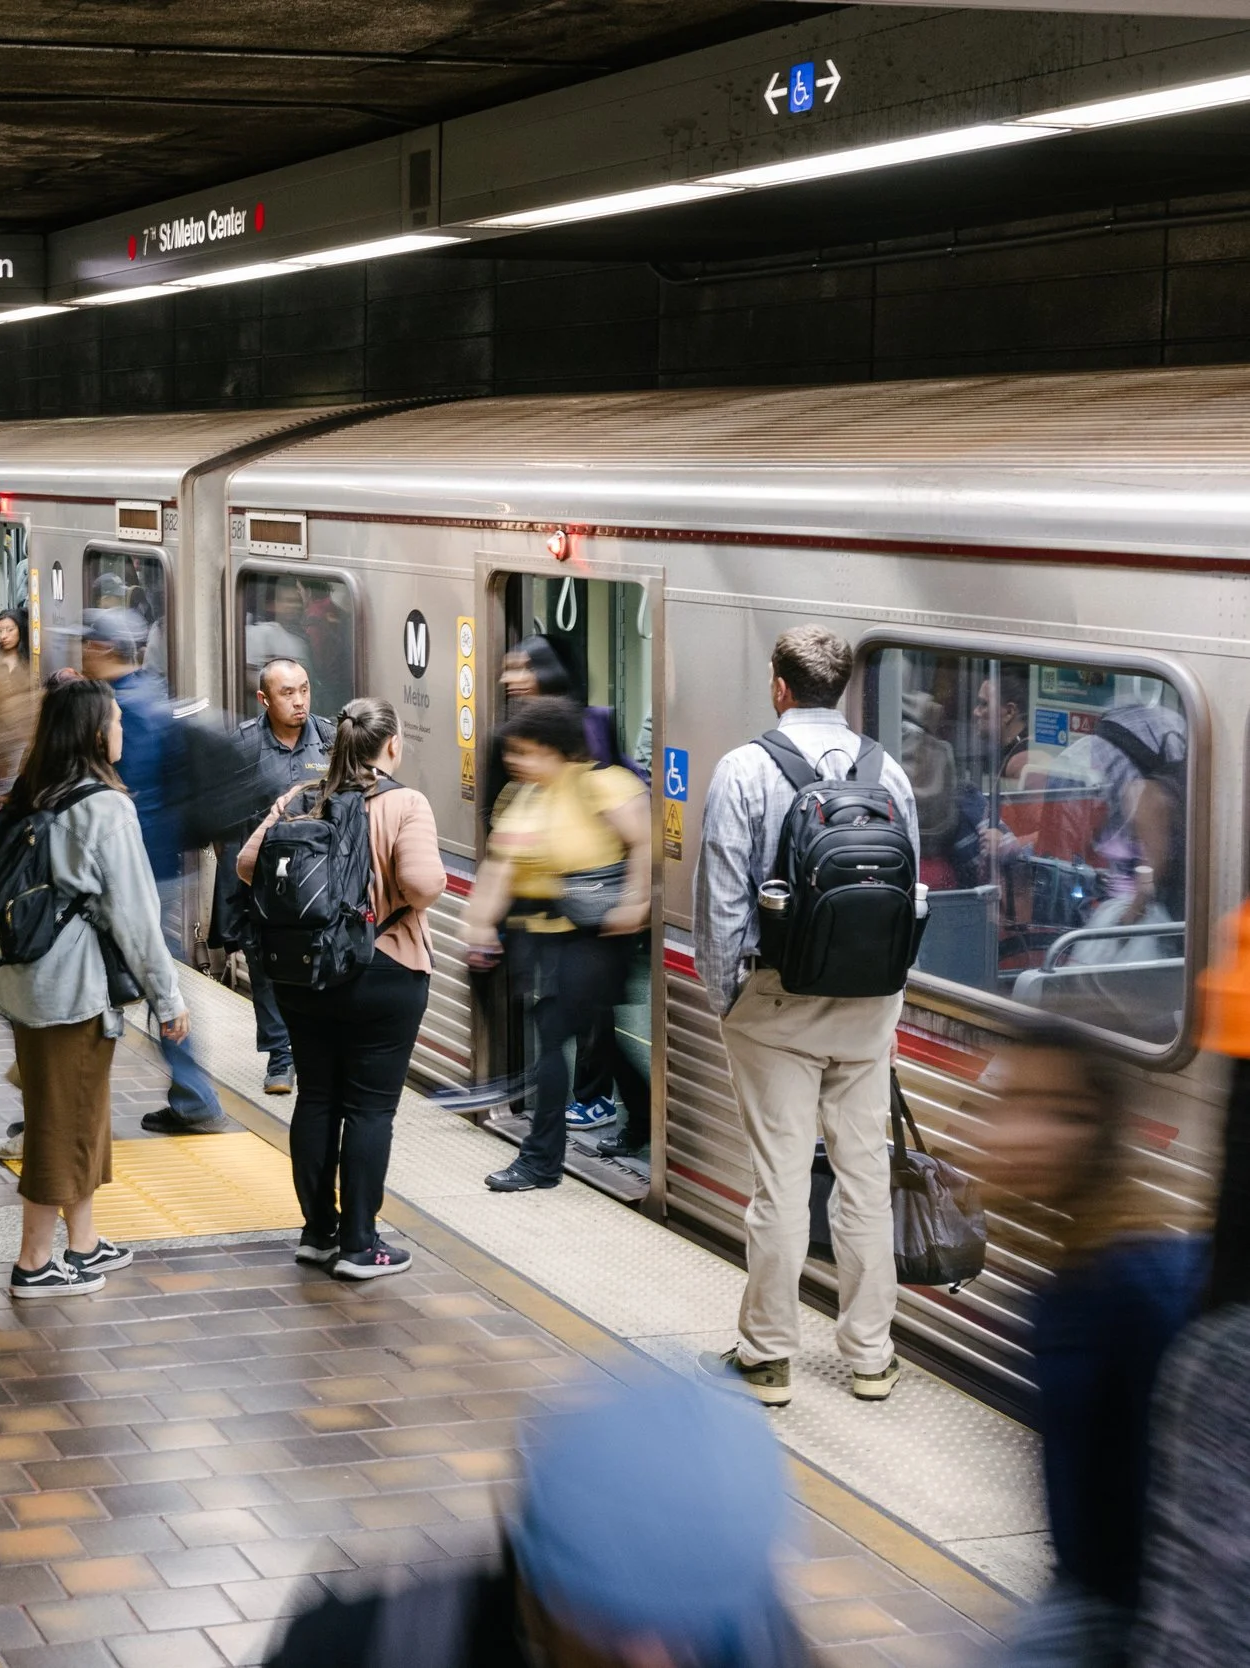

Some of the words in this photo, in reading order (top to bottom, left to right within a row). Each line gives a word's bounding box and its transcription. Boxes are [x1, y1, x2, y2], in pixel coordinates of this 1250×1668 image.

[158, 217, 206, 252] St/Metro
[207, 206, 248, 241] Center
[164, 513, 179, 531] 582
[231, 520, 246, 540] 581
[406, 620, 427, 669] M
[403, 684, 430, 709] Metro
